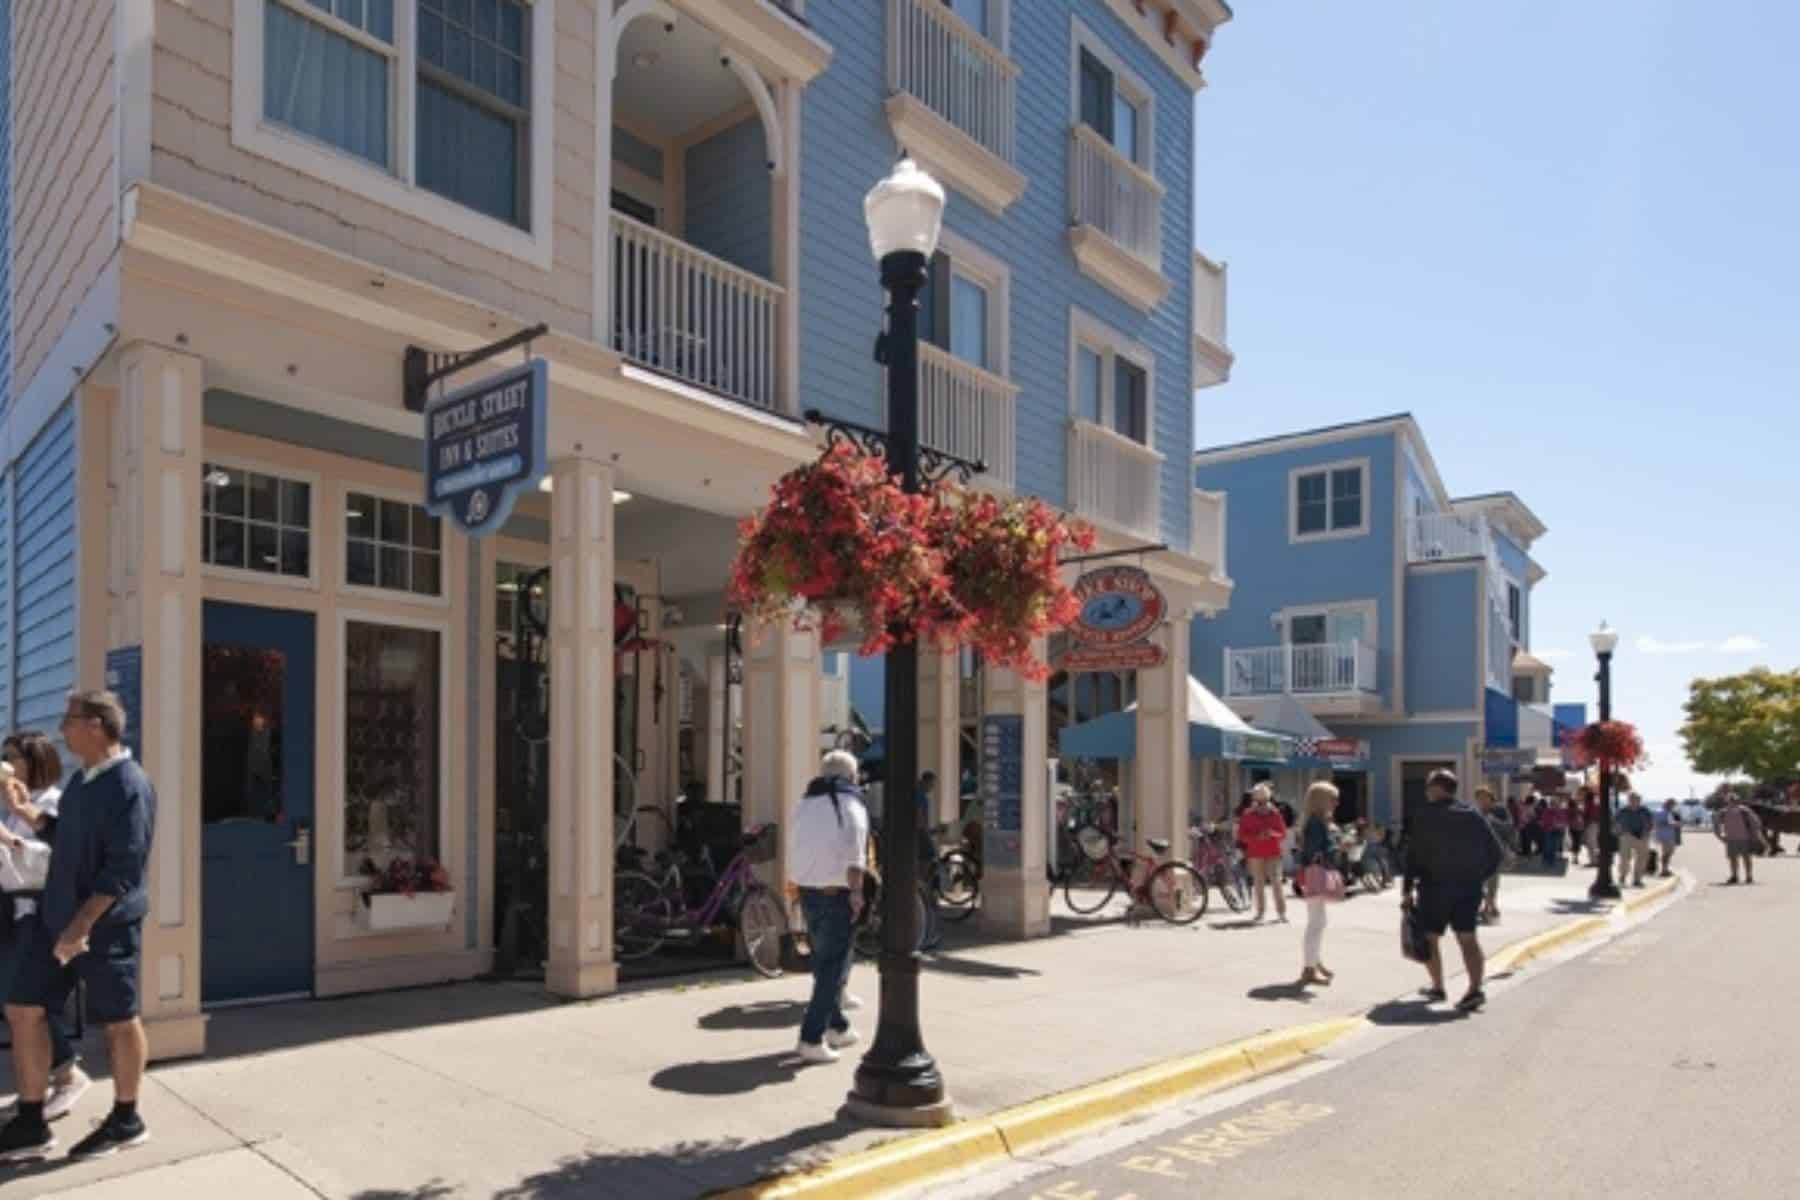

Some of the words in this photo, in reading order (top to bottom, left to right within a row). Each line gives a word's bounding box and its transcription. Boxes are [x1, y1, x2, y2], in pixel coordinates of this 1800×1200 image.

[433, 399, 476, 440] BICYCLE
[480, 380, 528, 421] STREET
[439, 442, 460, 471] INN
[463, 437, 474, 462] &
[476, 422, 520, 459] SUITES
